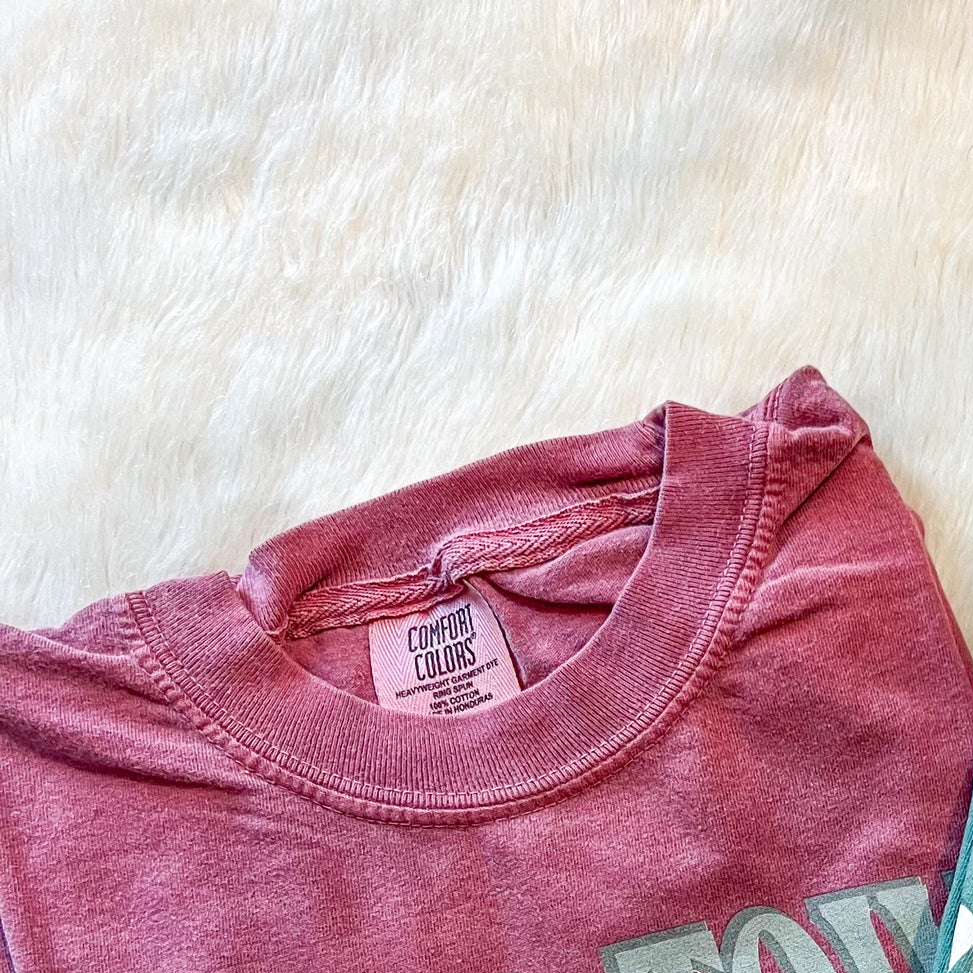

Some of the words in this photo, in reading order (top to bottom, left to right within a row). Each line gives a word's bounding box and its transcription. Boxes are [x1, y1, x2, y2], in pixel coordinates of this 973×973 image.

[407, 604, 474, 652] COMFORT
[395, 678, 450, 699] HEAVYWEIGHT
[452, 667, 486, 683] GARMENT
[487, 658, 499, 671] DYE
[433, 687, 452, 699] RING
[454, 681, 474, 694] SPUN
[429, 700, 449, 711] 100%
[450, 688, 480, 704] COTTON
[444, 707, 453, 715] IN
[454, 692, 493, 713] HONDURAS
